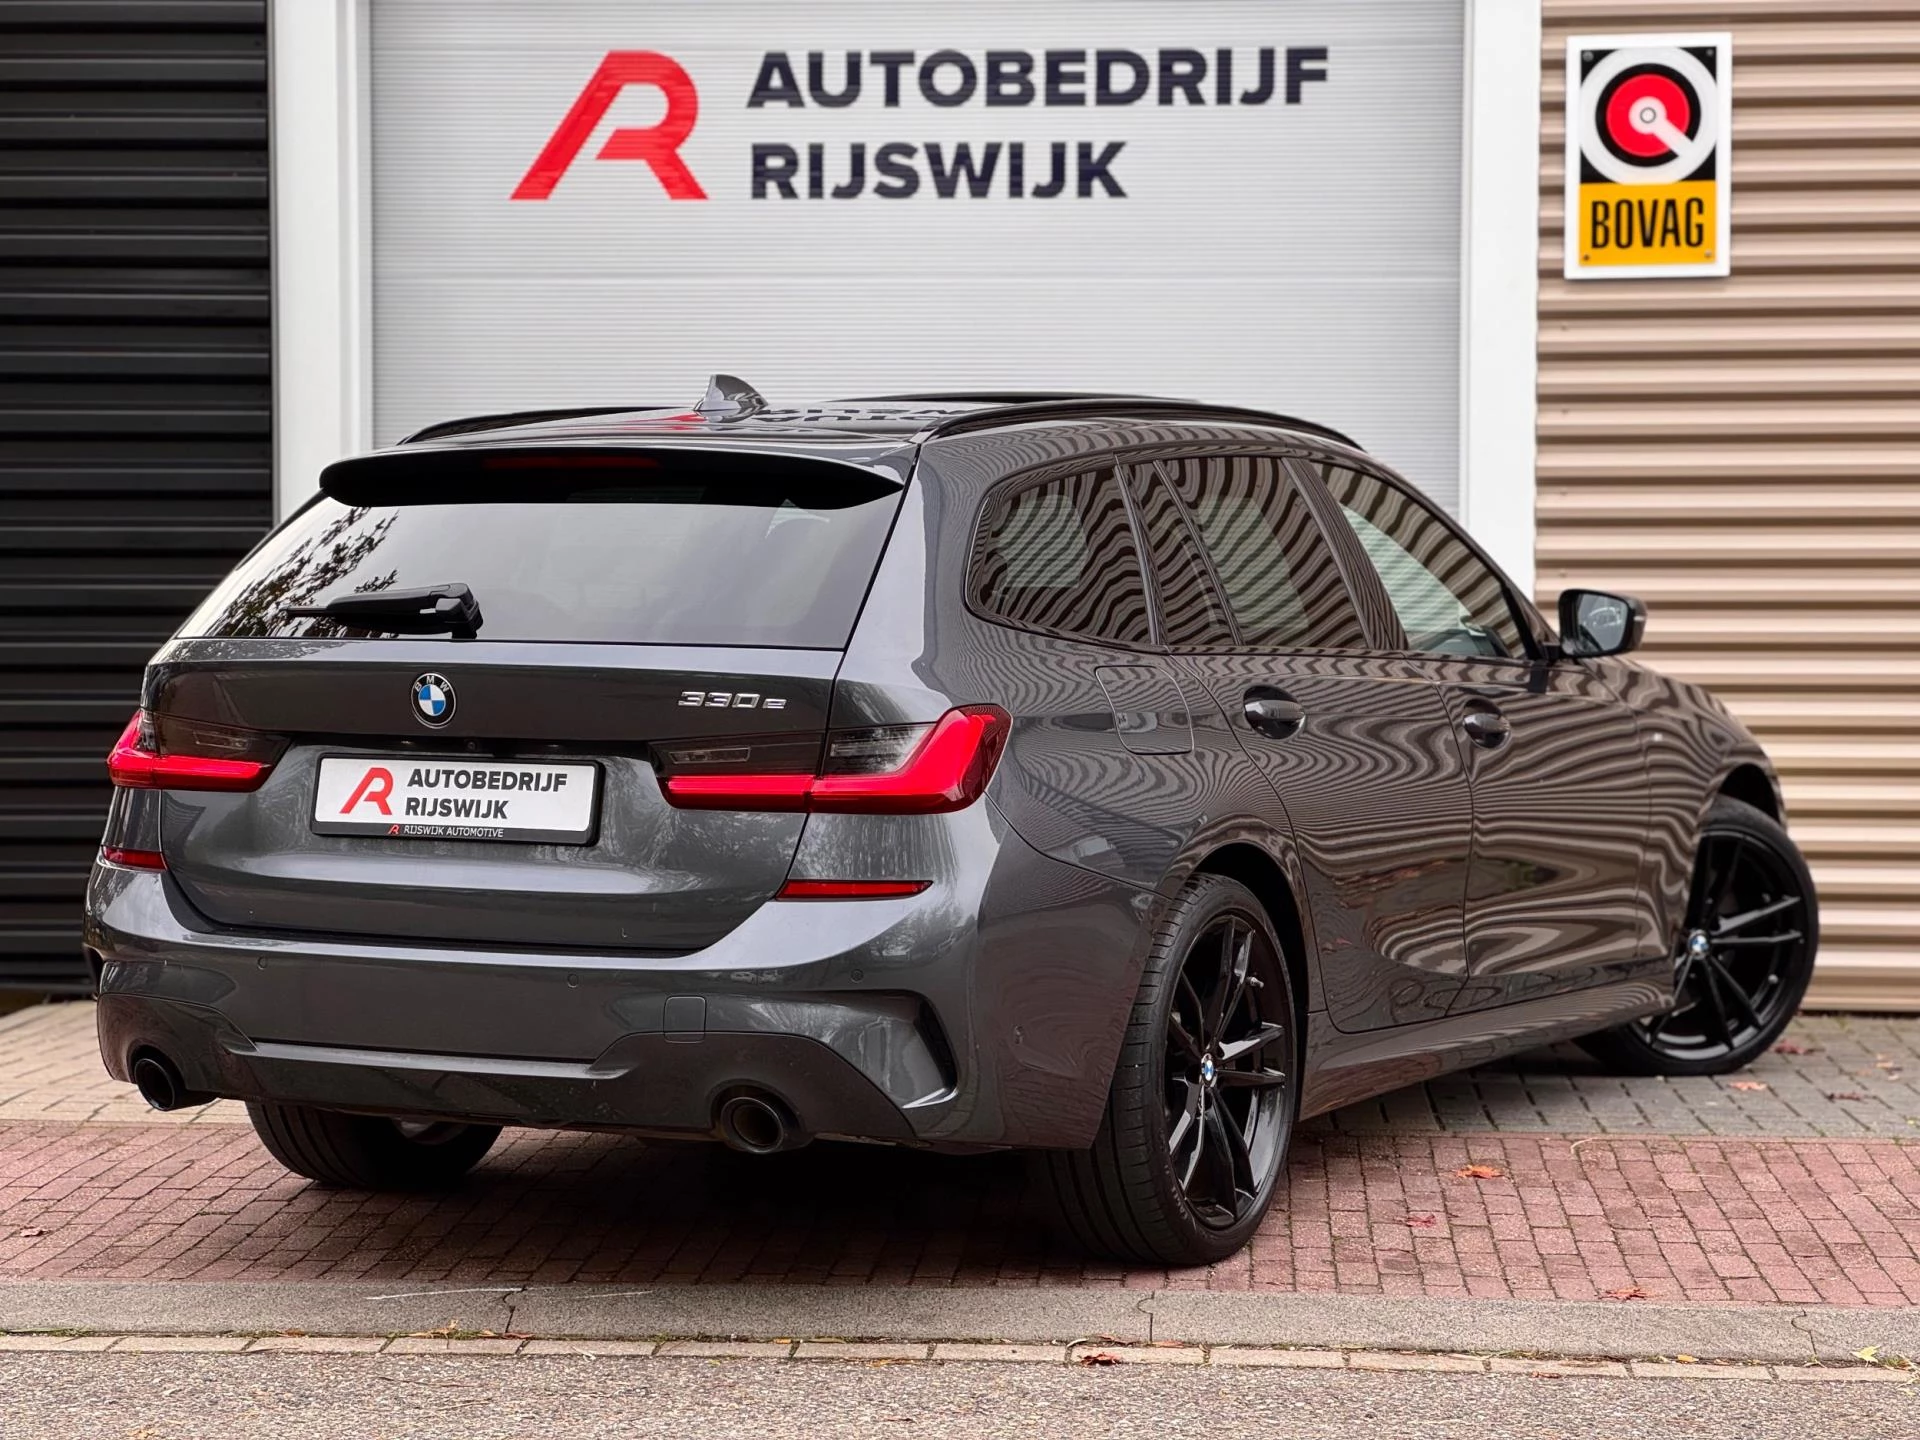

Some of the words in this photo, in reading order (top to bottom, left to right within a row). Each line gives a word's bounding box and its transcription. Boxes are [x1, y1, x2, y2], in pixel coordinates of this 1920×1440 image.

[746, 46, 1328, 108] AUTOBEDRIJF
[750, 141, 1127, 200] RIJSWIJK
[1591, 197, 1704, 249] BOVAG
[414, 675, 450, 692] BMW
[678, 691, 787, 709] 330e
[407, 768, 568, 792] AUTOBEDRIJF
[405, 797, 508, 819] RIJSWIJK
[403, 825, 444, 835] RIJSWIJK
[446, 827, 504, 838] AUTOMOTIVE
